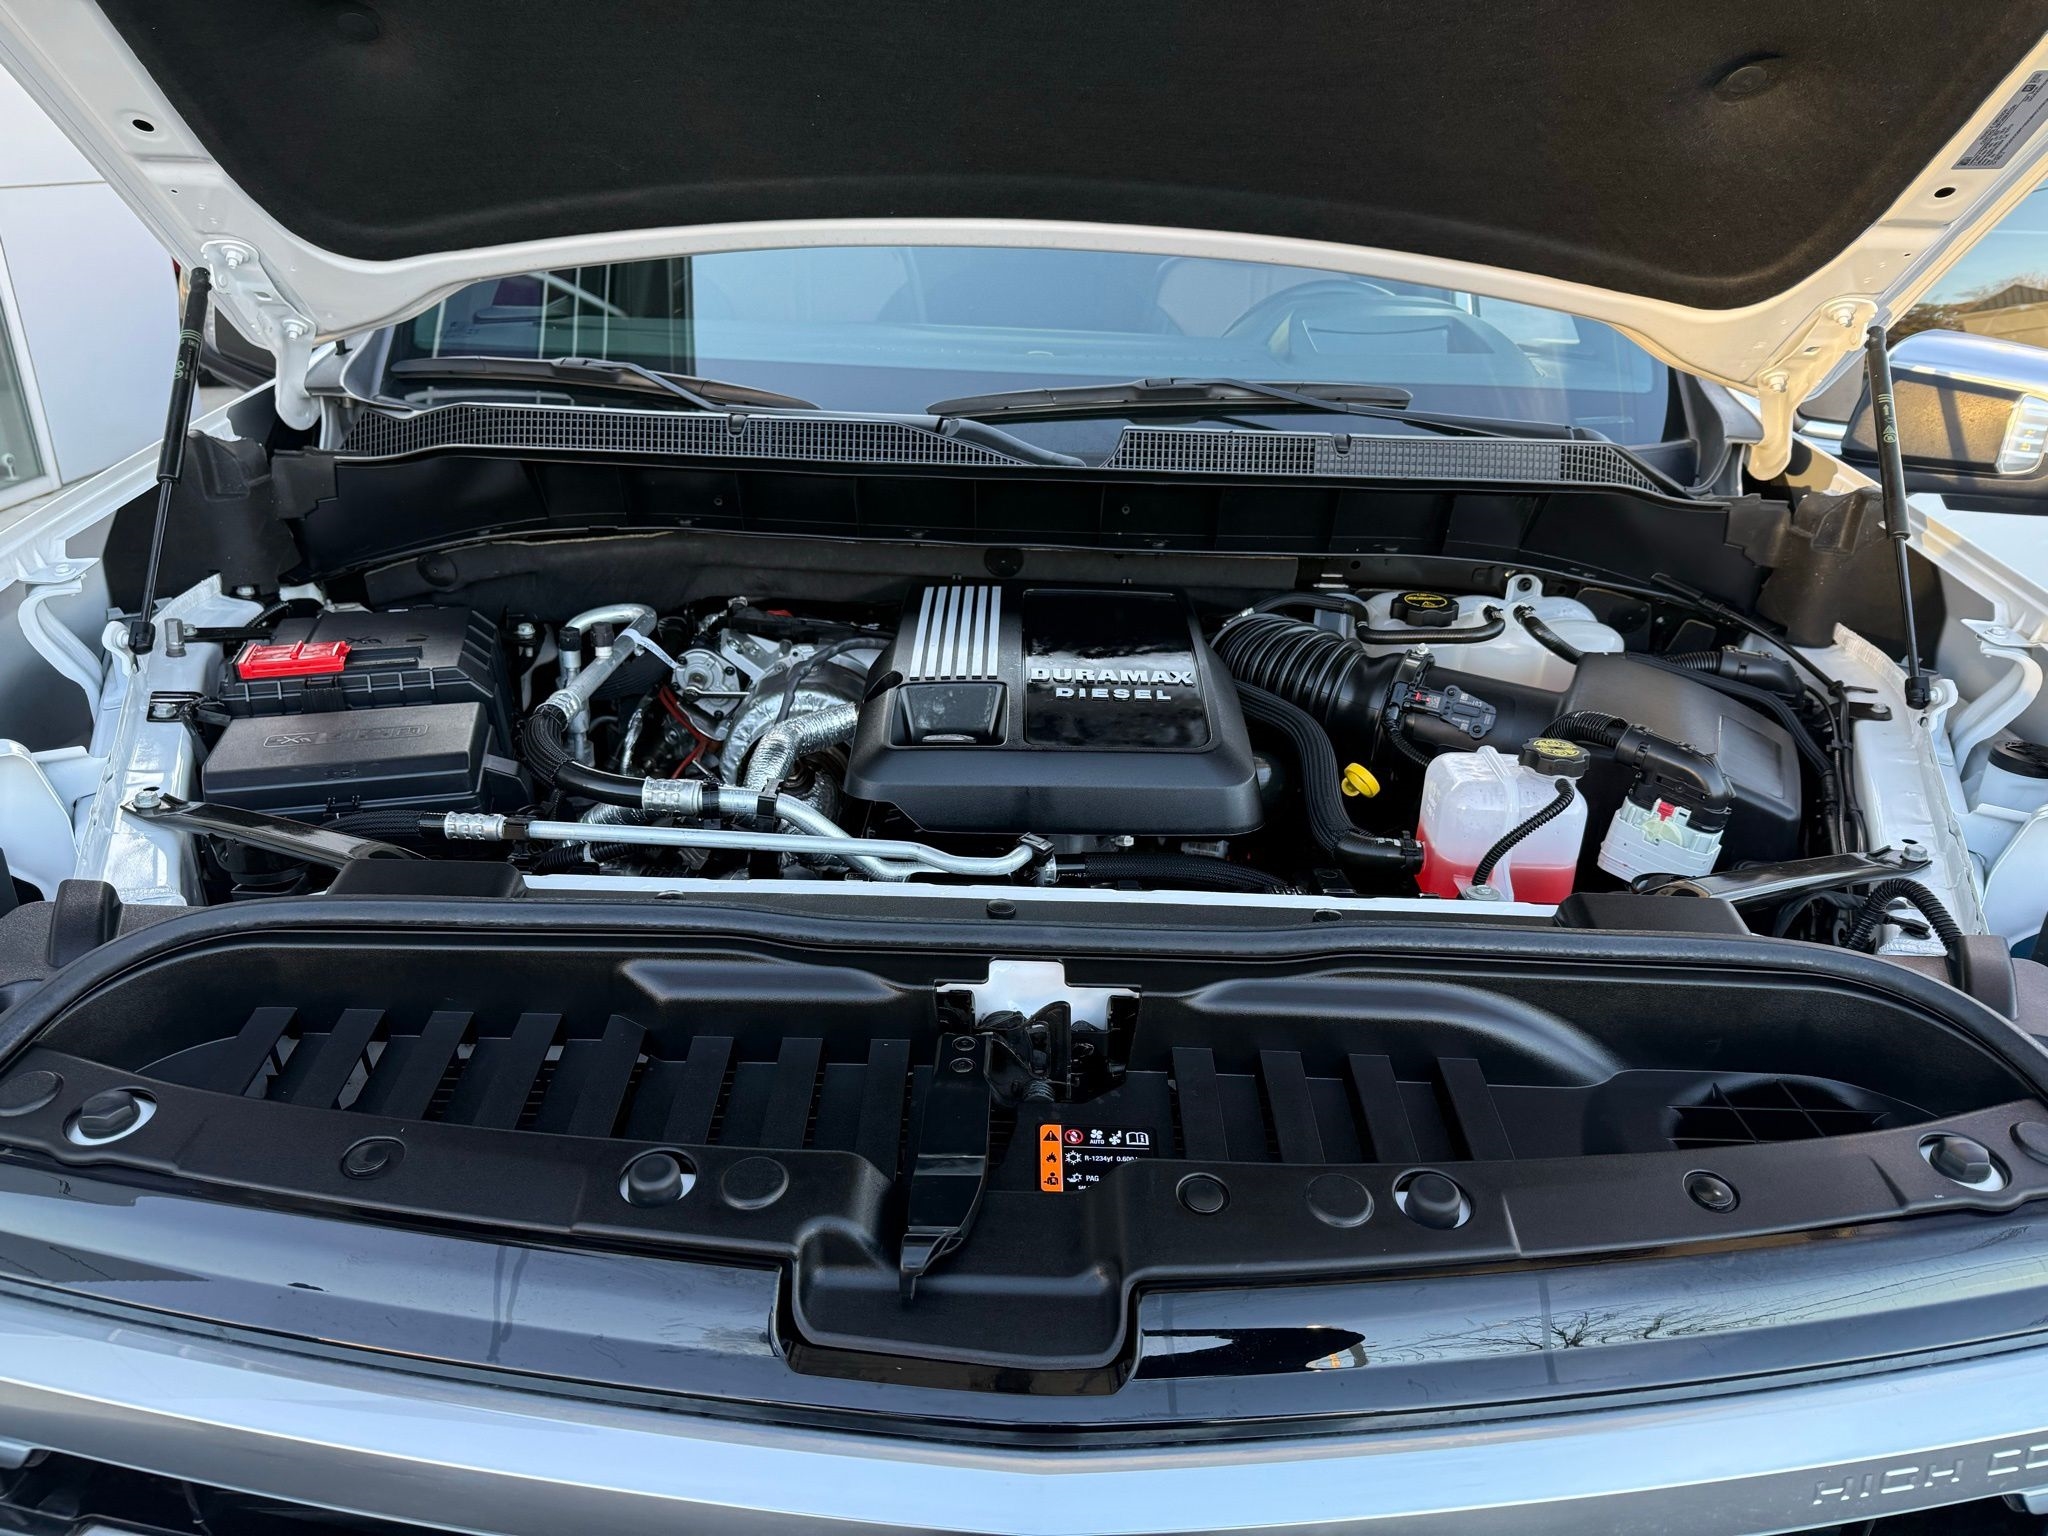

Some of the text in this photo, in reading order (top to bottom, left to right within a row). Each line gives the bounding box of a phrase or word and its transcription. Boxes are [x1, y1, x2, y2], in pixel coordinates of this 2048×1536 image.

[1030, 668, 1194, 686] DURAMAX
[1055, 687, 1172, 702] DIESEL
[1813, 1460, 1964, 1505] HIGH
